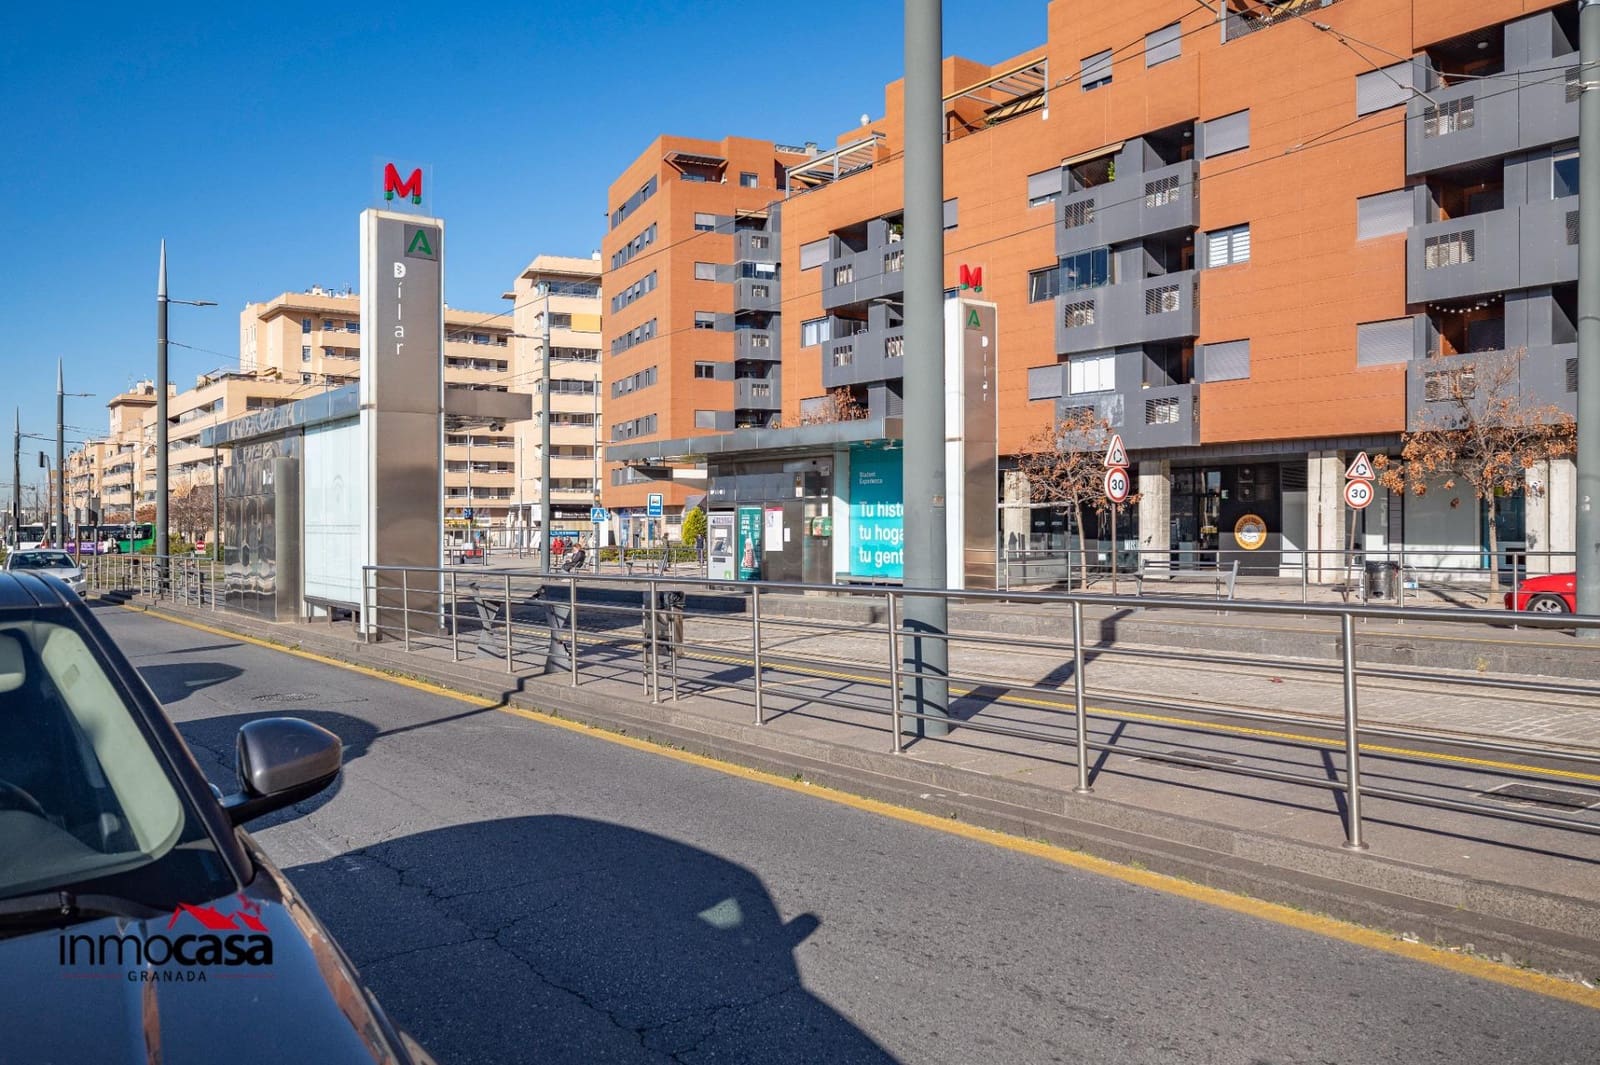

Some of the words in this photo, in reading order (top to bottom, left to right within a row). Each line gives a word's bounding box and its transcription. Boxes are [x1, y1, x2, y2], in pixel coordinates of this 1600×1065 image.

[383, 162, 423, 205] M
[1111, 479, 1125, 491] 30
[1351, 488, 1367, 499] 30
[859, 501, 873, 517] Tu
[859, 525, 871, 540] tu
[859, 549, 871, 563] tu
